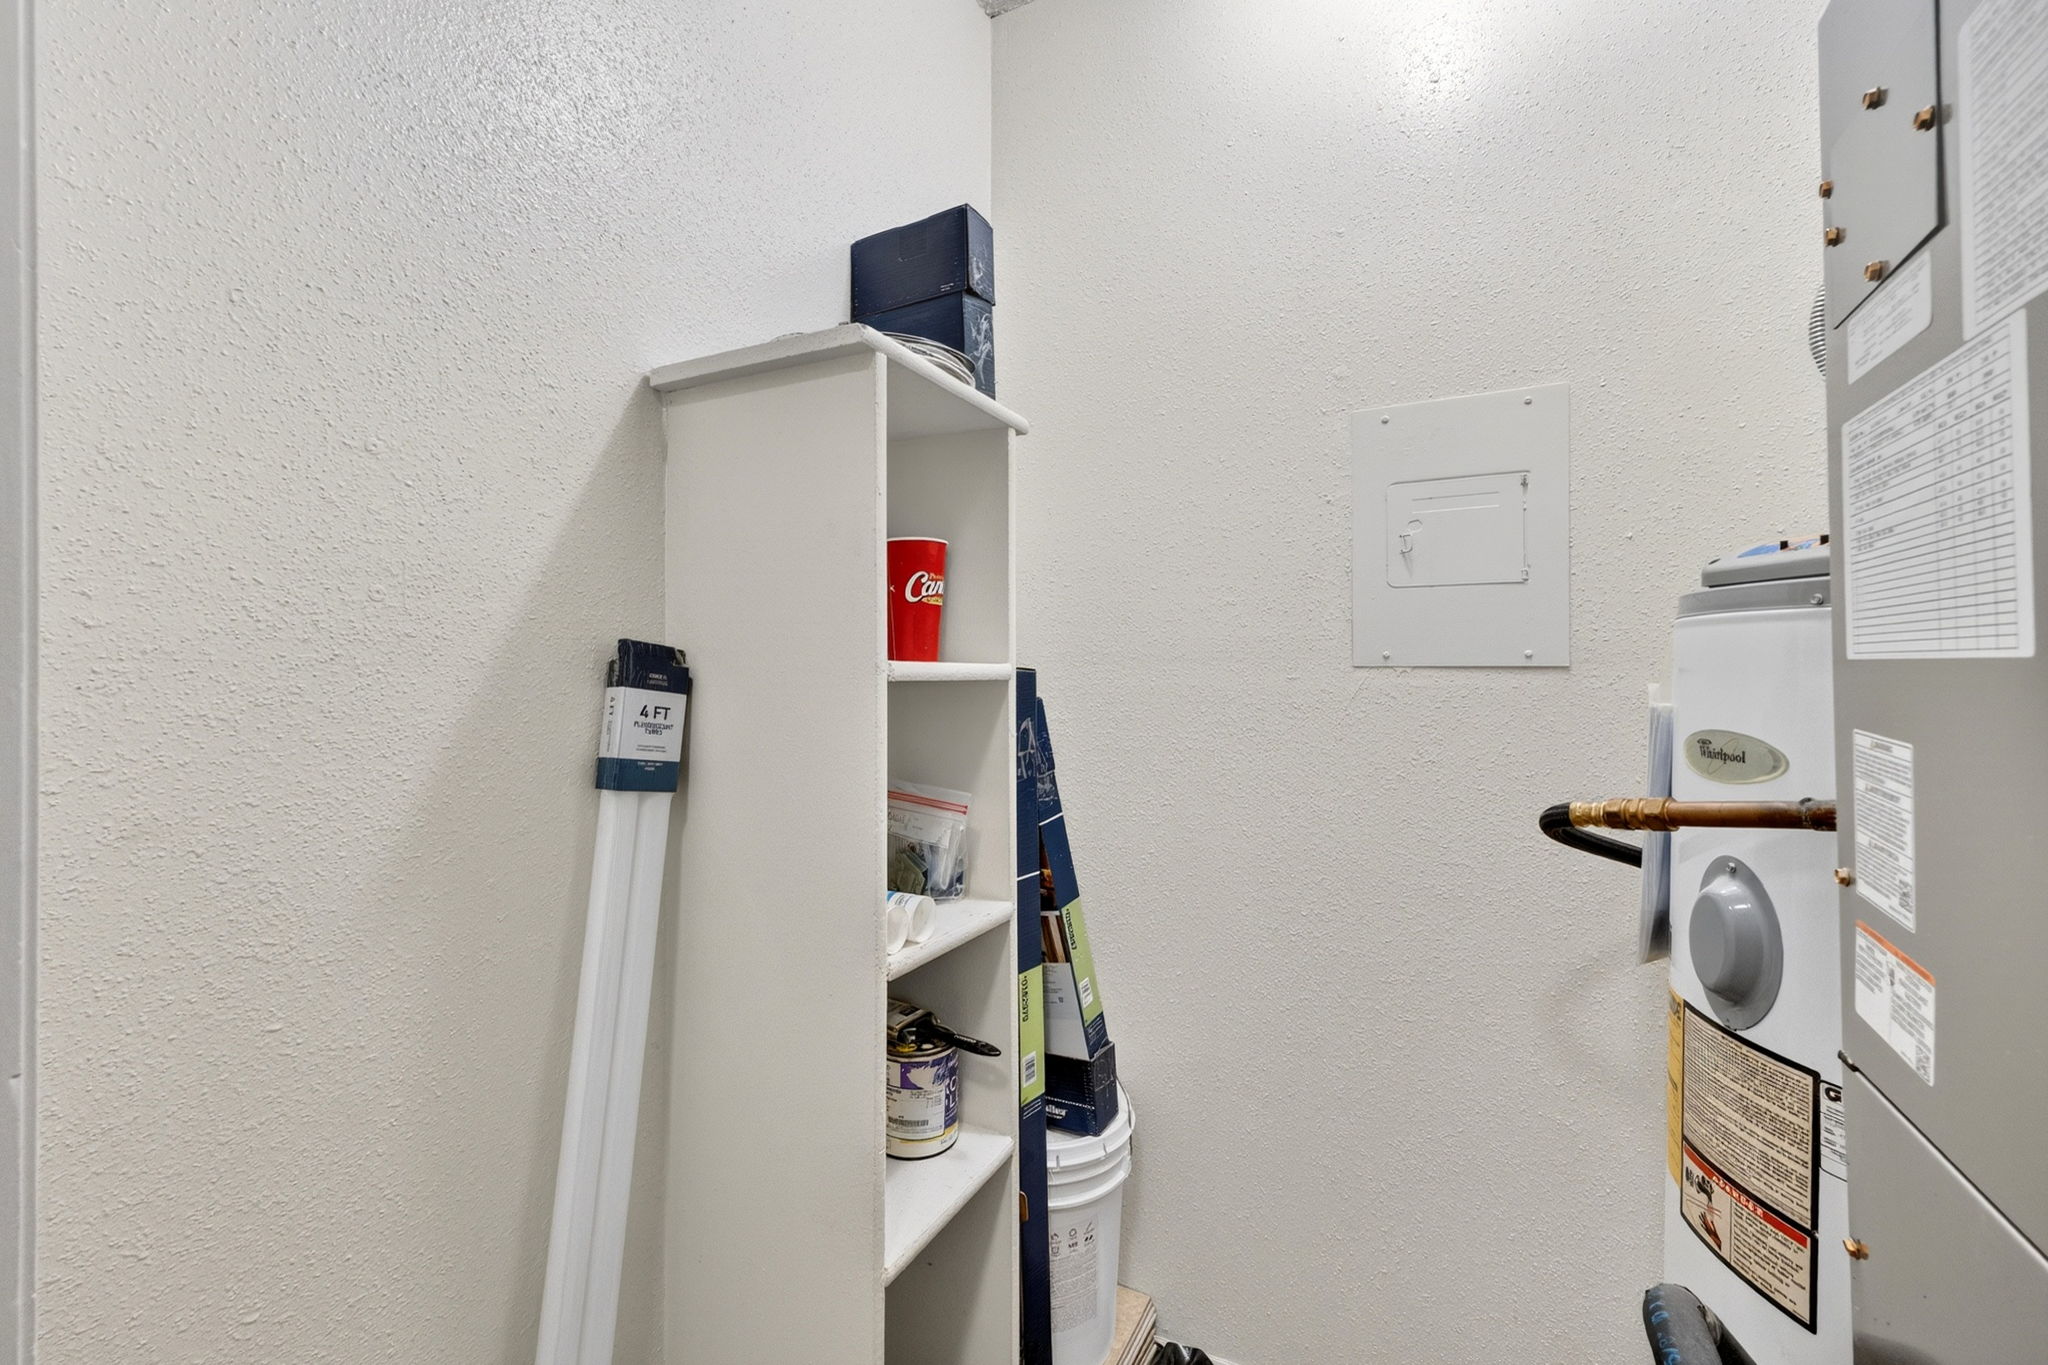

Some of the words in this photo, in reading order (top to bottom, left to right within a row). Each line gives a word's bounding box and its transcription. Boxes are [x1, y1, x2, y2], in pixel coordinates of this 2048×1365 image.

[639, 704, 649, 719] 4
[653, 705, 671, 721] FT
[1699, 745, 1746, 765] Whirlpool
